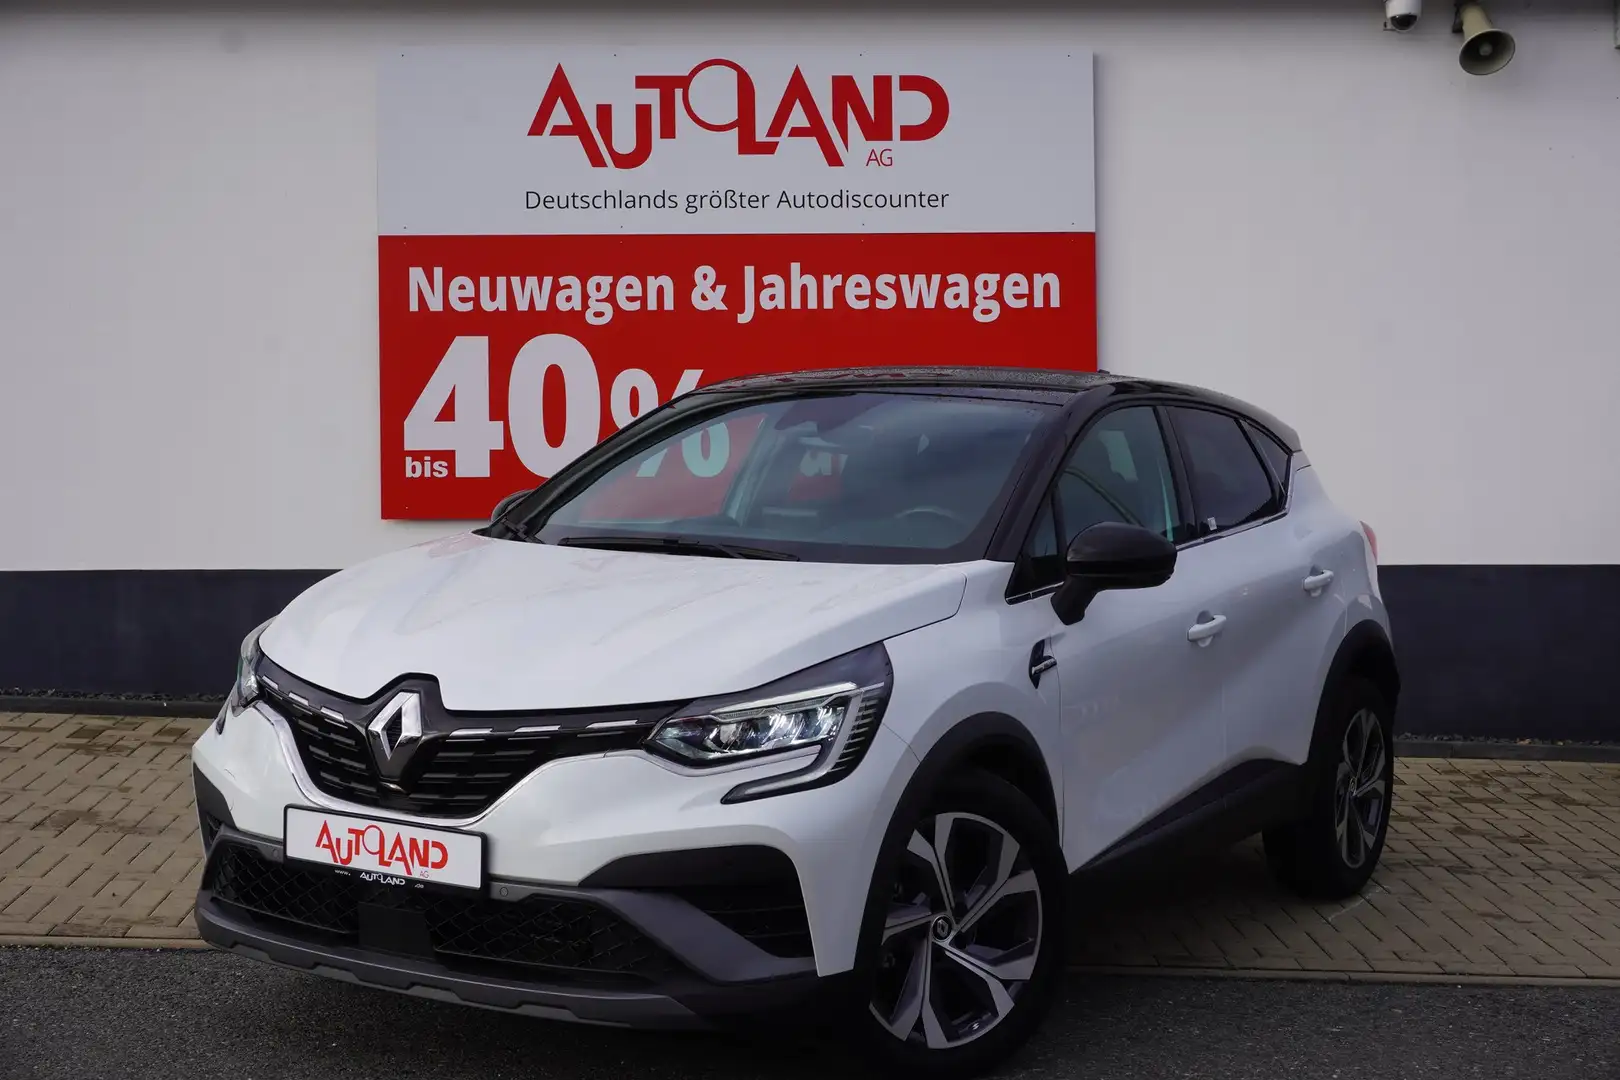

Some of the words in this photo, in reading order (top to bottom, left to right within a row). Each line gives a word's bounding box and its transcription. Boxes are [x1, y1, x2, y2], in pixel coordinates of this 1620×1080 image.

[528, 59, 950, 169] AUTOLAND
[865, 148, 894, 168] AG
[525, 189, 679, 210] Deutschlands
[685, 189, 770, 215] größter
[776, 188, 950, 209] Autodiscounter
[408, 266, 675, 325] Neuwagen
[691, 265, 728, 311] &
[737, 262, 1061, 324] Jahreswagen
[404, 455, 449, 479] bis
[315, 820, 449, 876] AUTOLAND
